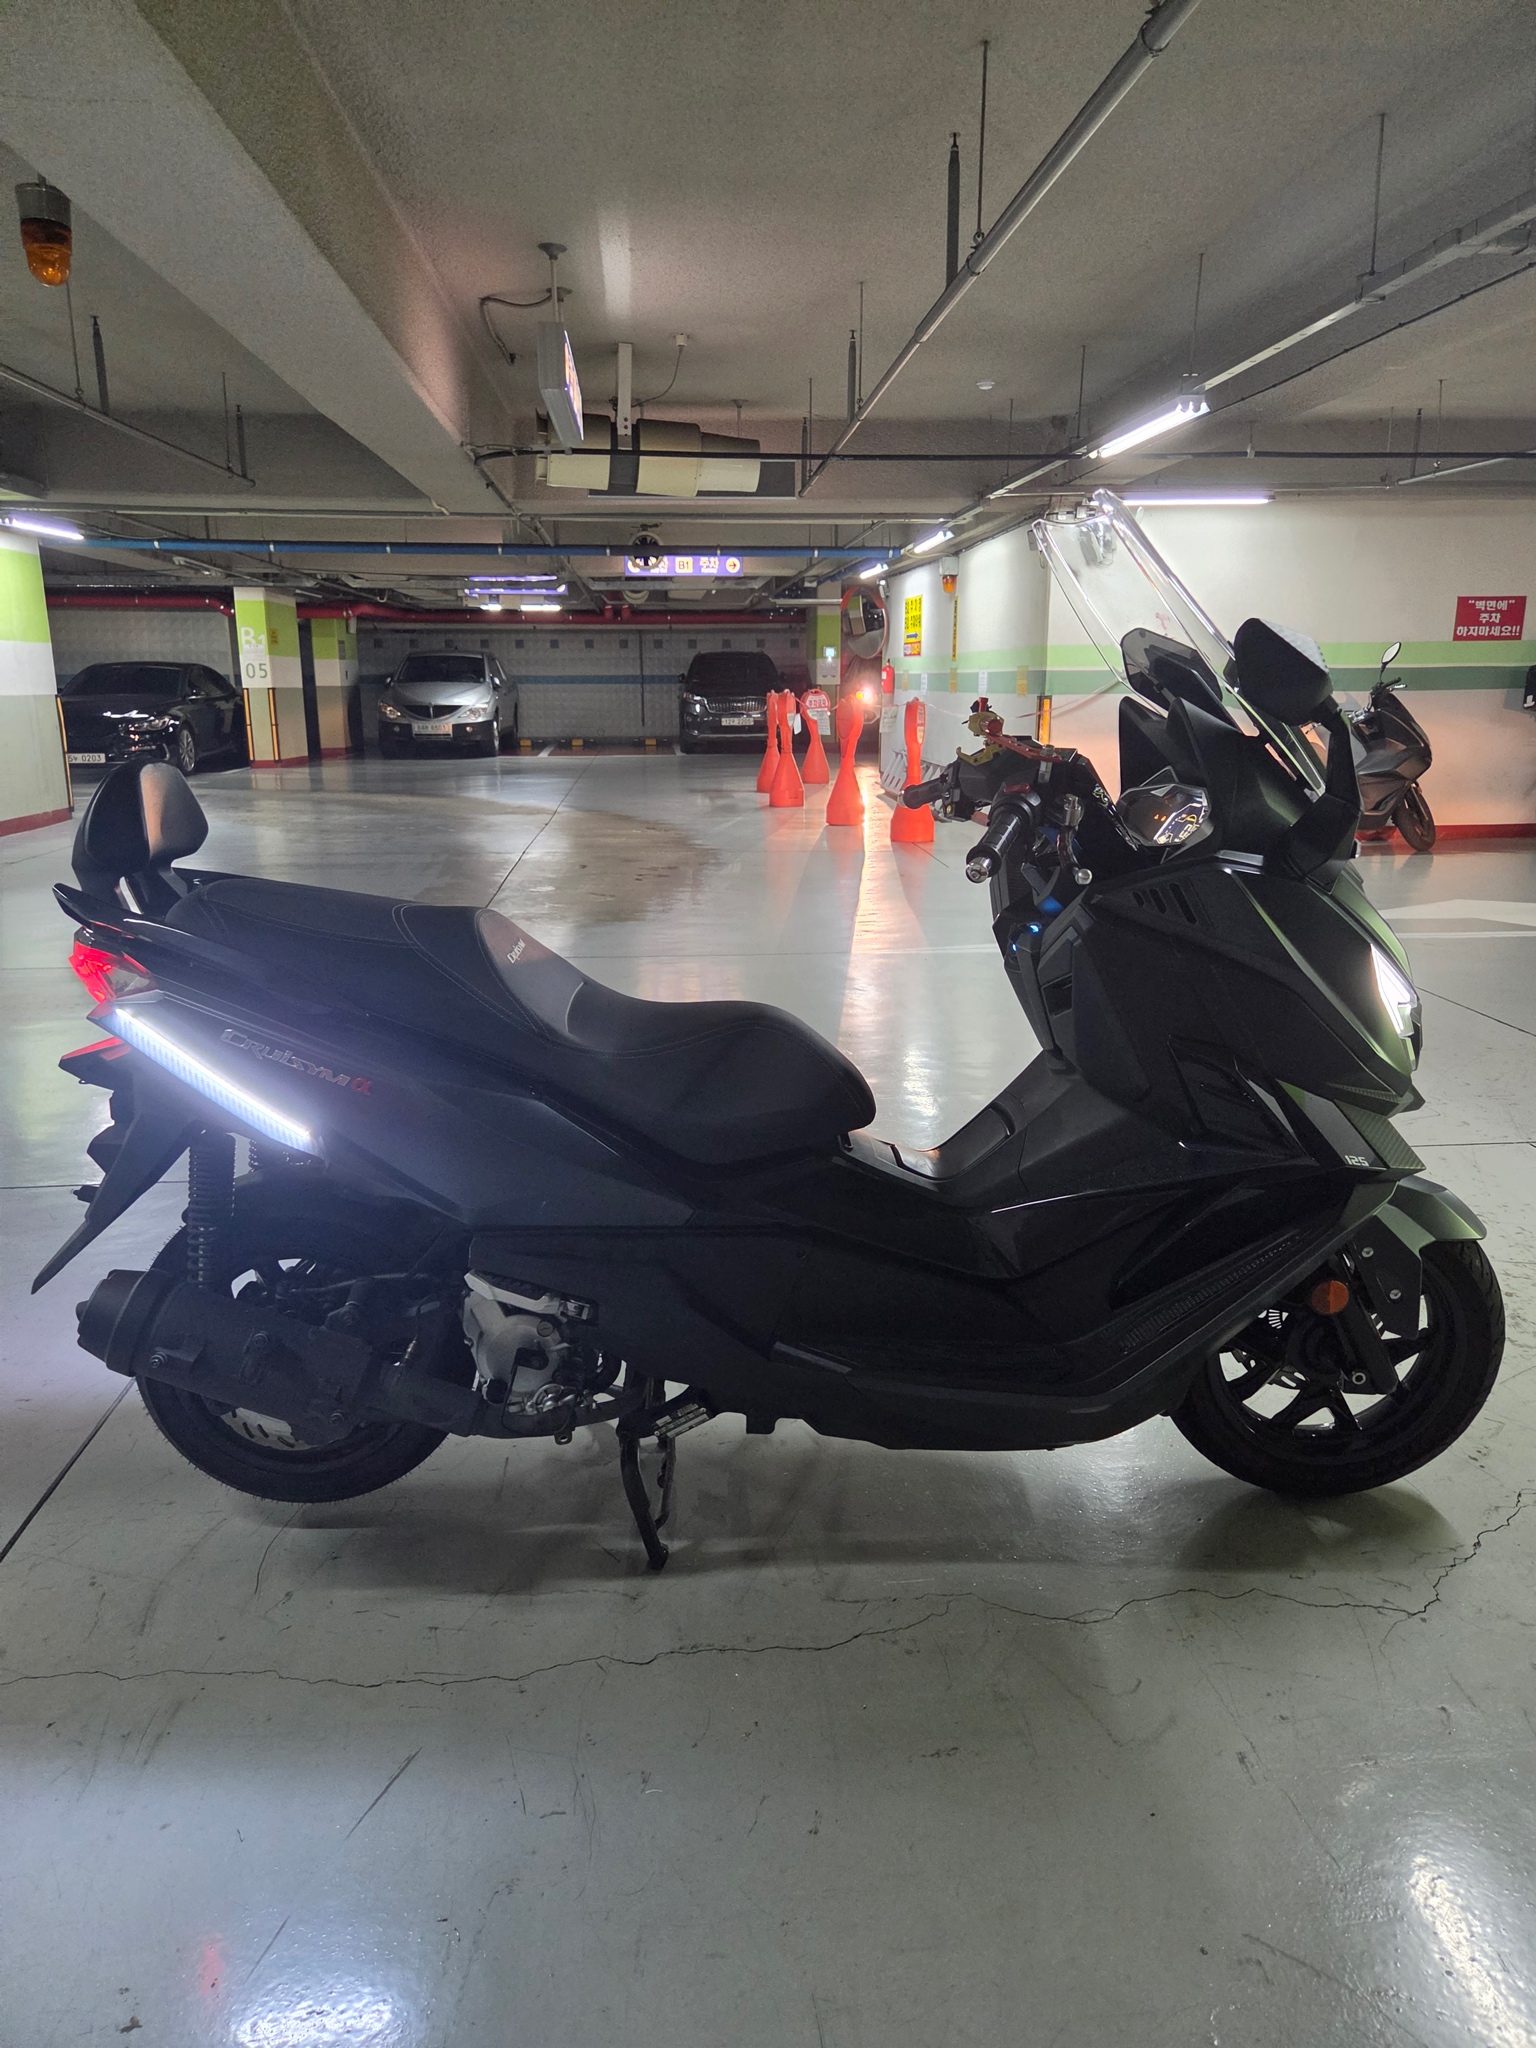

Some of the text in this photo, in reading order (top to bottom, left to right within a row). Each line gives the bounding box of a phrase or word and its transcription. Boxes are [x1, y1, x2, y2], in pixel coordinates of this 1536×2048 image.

[678, 560, 689, 570] B1
[700, 557, 719, 569] 주차
[1479, 613, 1501, 624] 주차
[1456, 625, 1520, 637] 하지마세요!!
[246, 663, 268, 679] 05
[81, 754, 102, 763] 0203
[1344, 1155, 1370, 1166] 125
